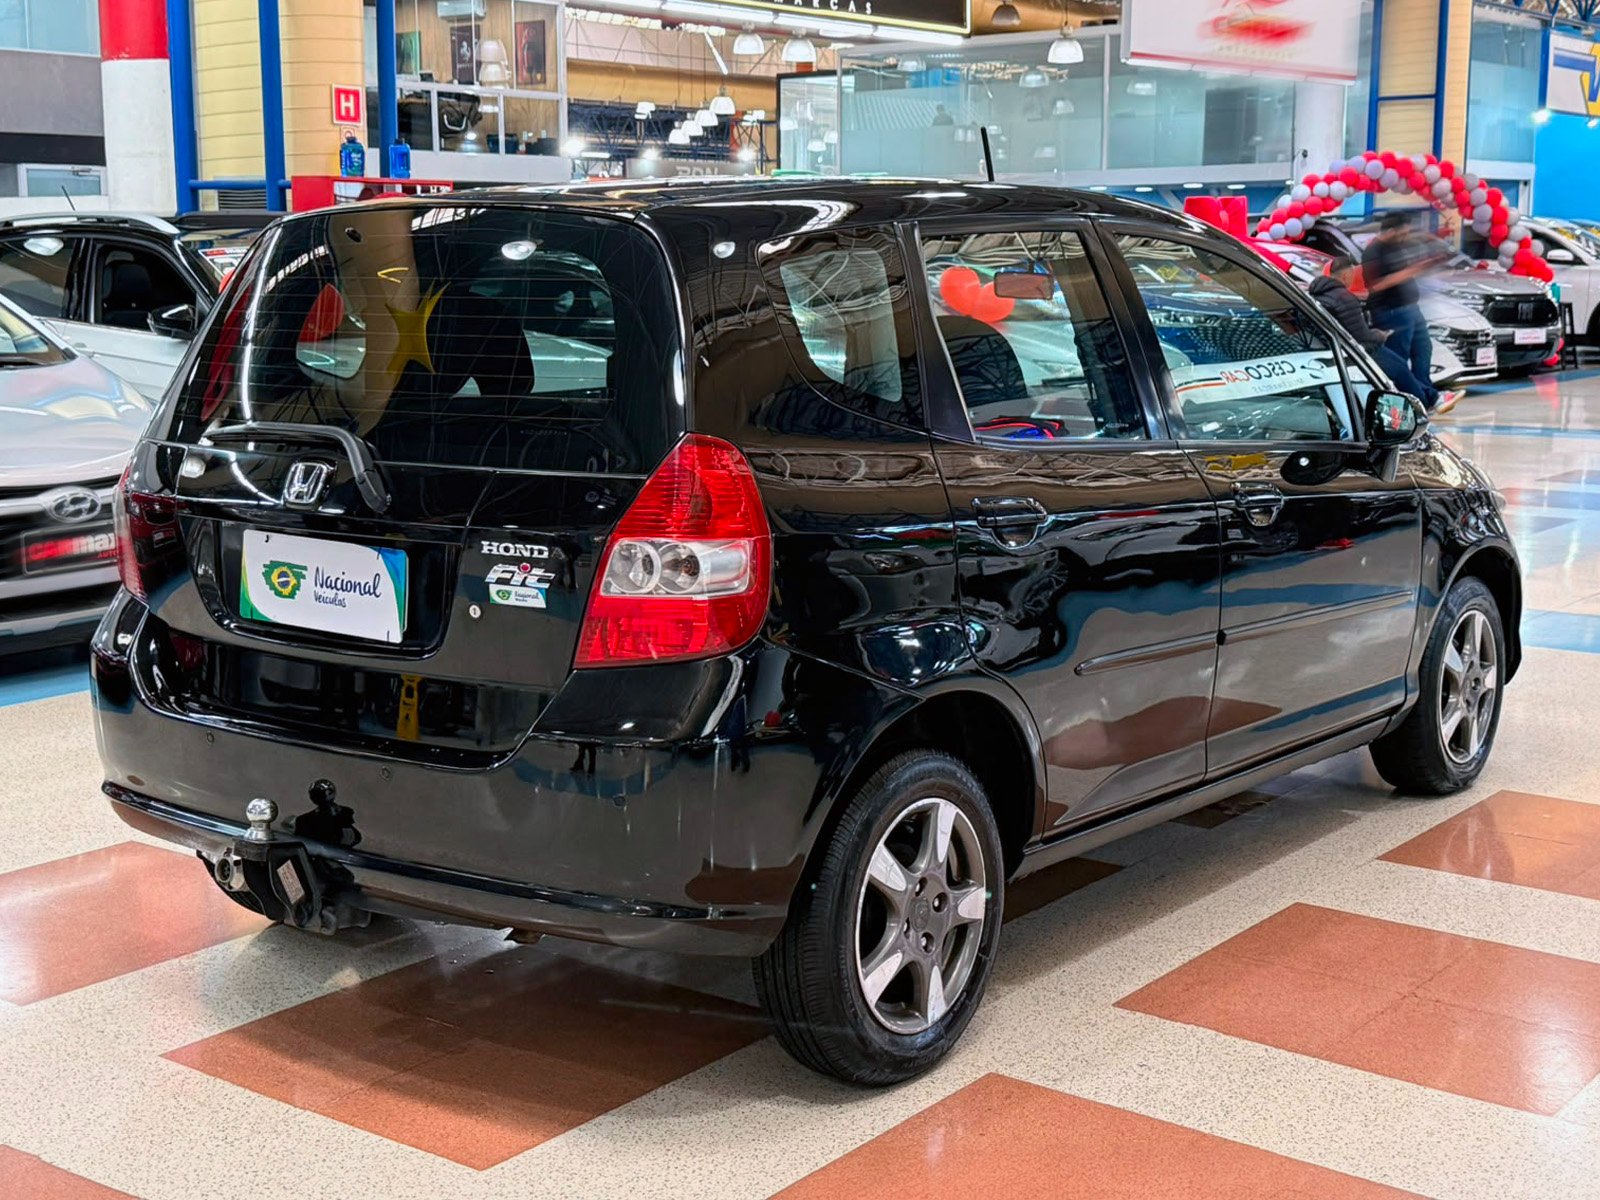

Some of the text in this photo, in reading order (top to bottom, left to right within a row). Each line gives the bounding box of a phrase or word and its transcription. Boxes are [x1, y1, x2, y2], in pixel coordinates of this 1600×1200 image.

[340, 93, 355, 117] H
[480, 540, 566, 560] HONDA
[314, 566, 382, 598] Nacional
